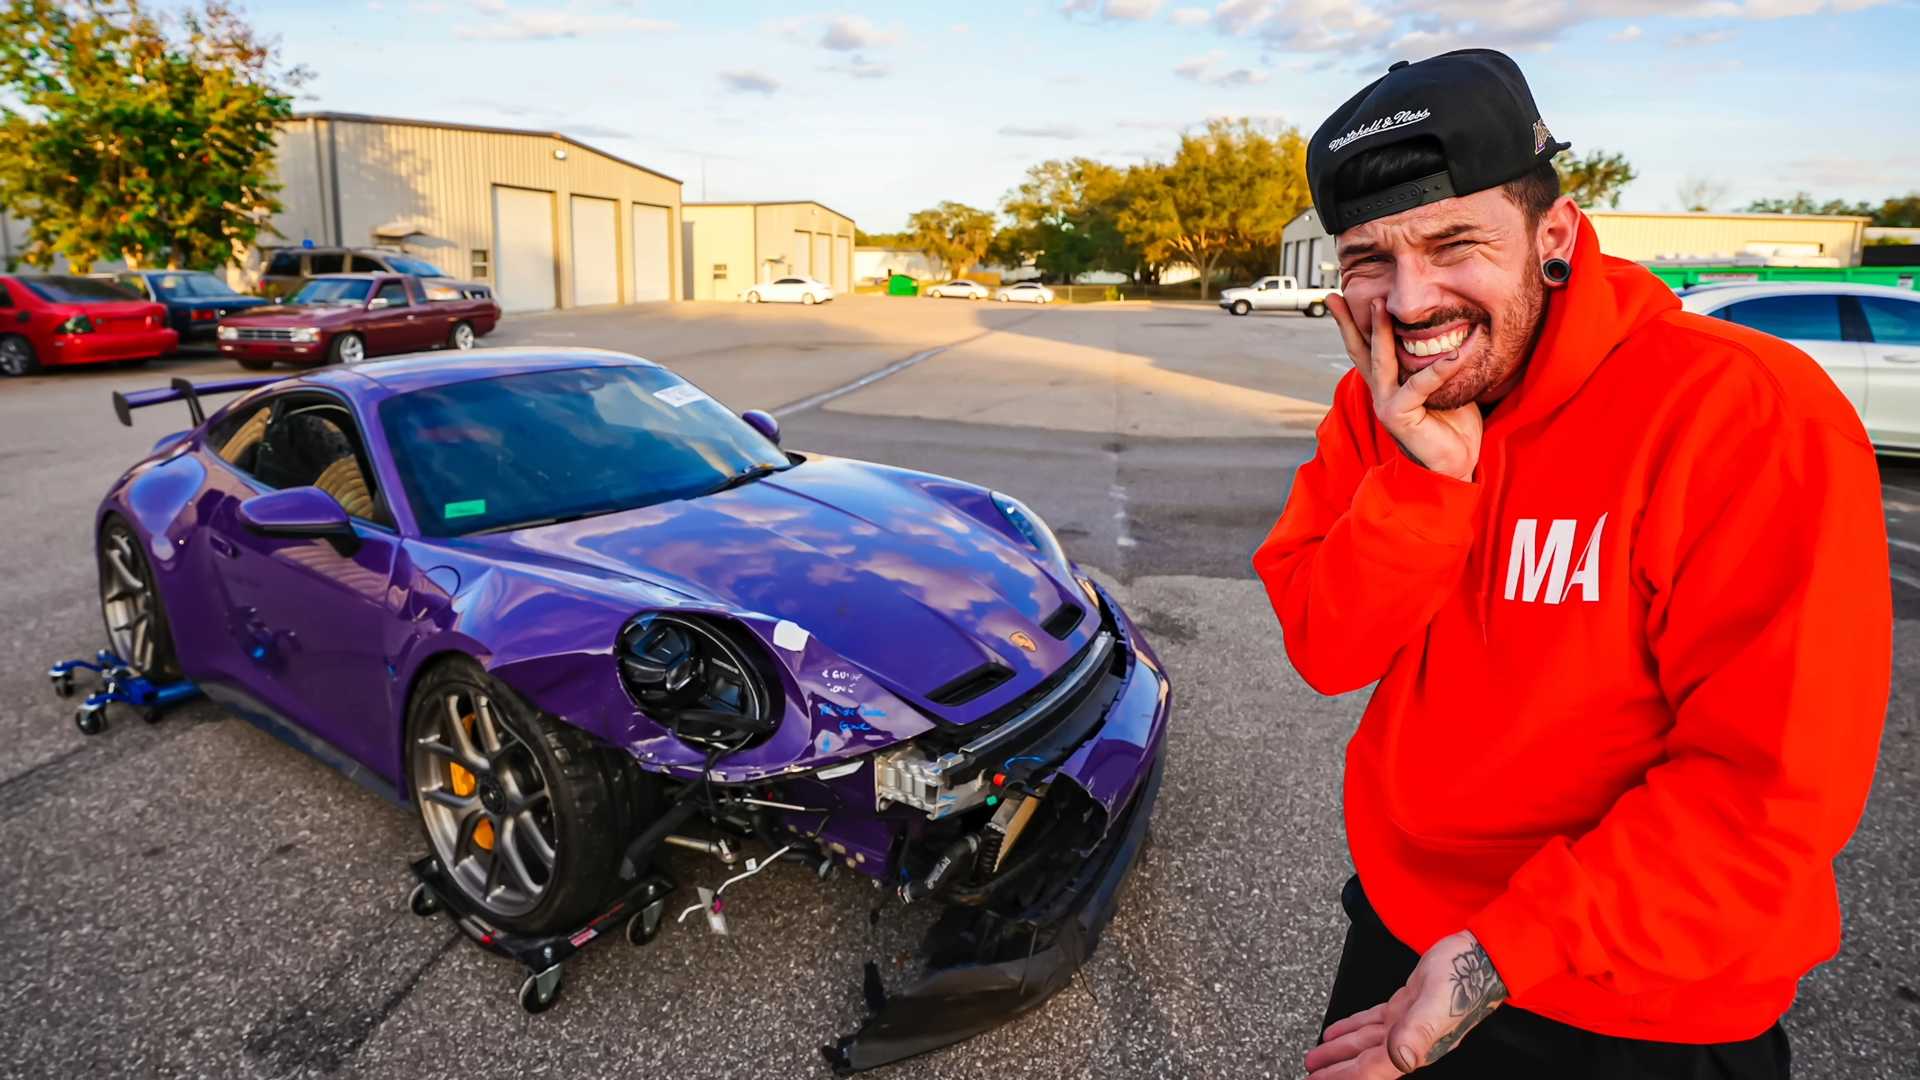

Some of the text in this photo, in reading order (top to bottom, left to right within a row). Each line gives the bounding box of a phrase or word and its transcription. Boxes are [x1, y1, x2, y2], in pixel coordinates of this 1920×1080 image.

[1328, 108, 1431, 152] Mitchell & Ness
[1504, 511, 1609, 605] MA
